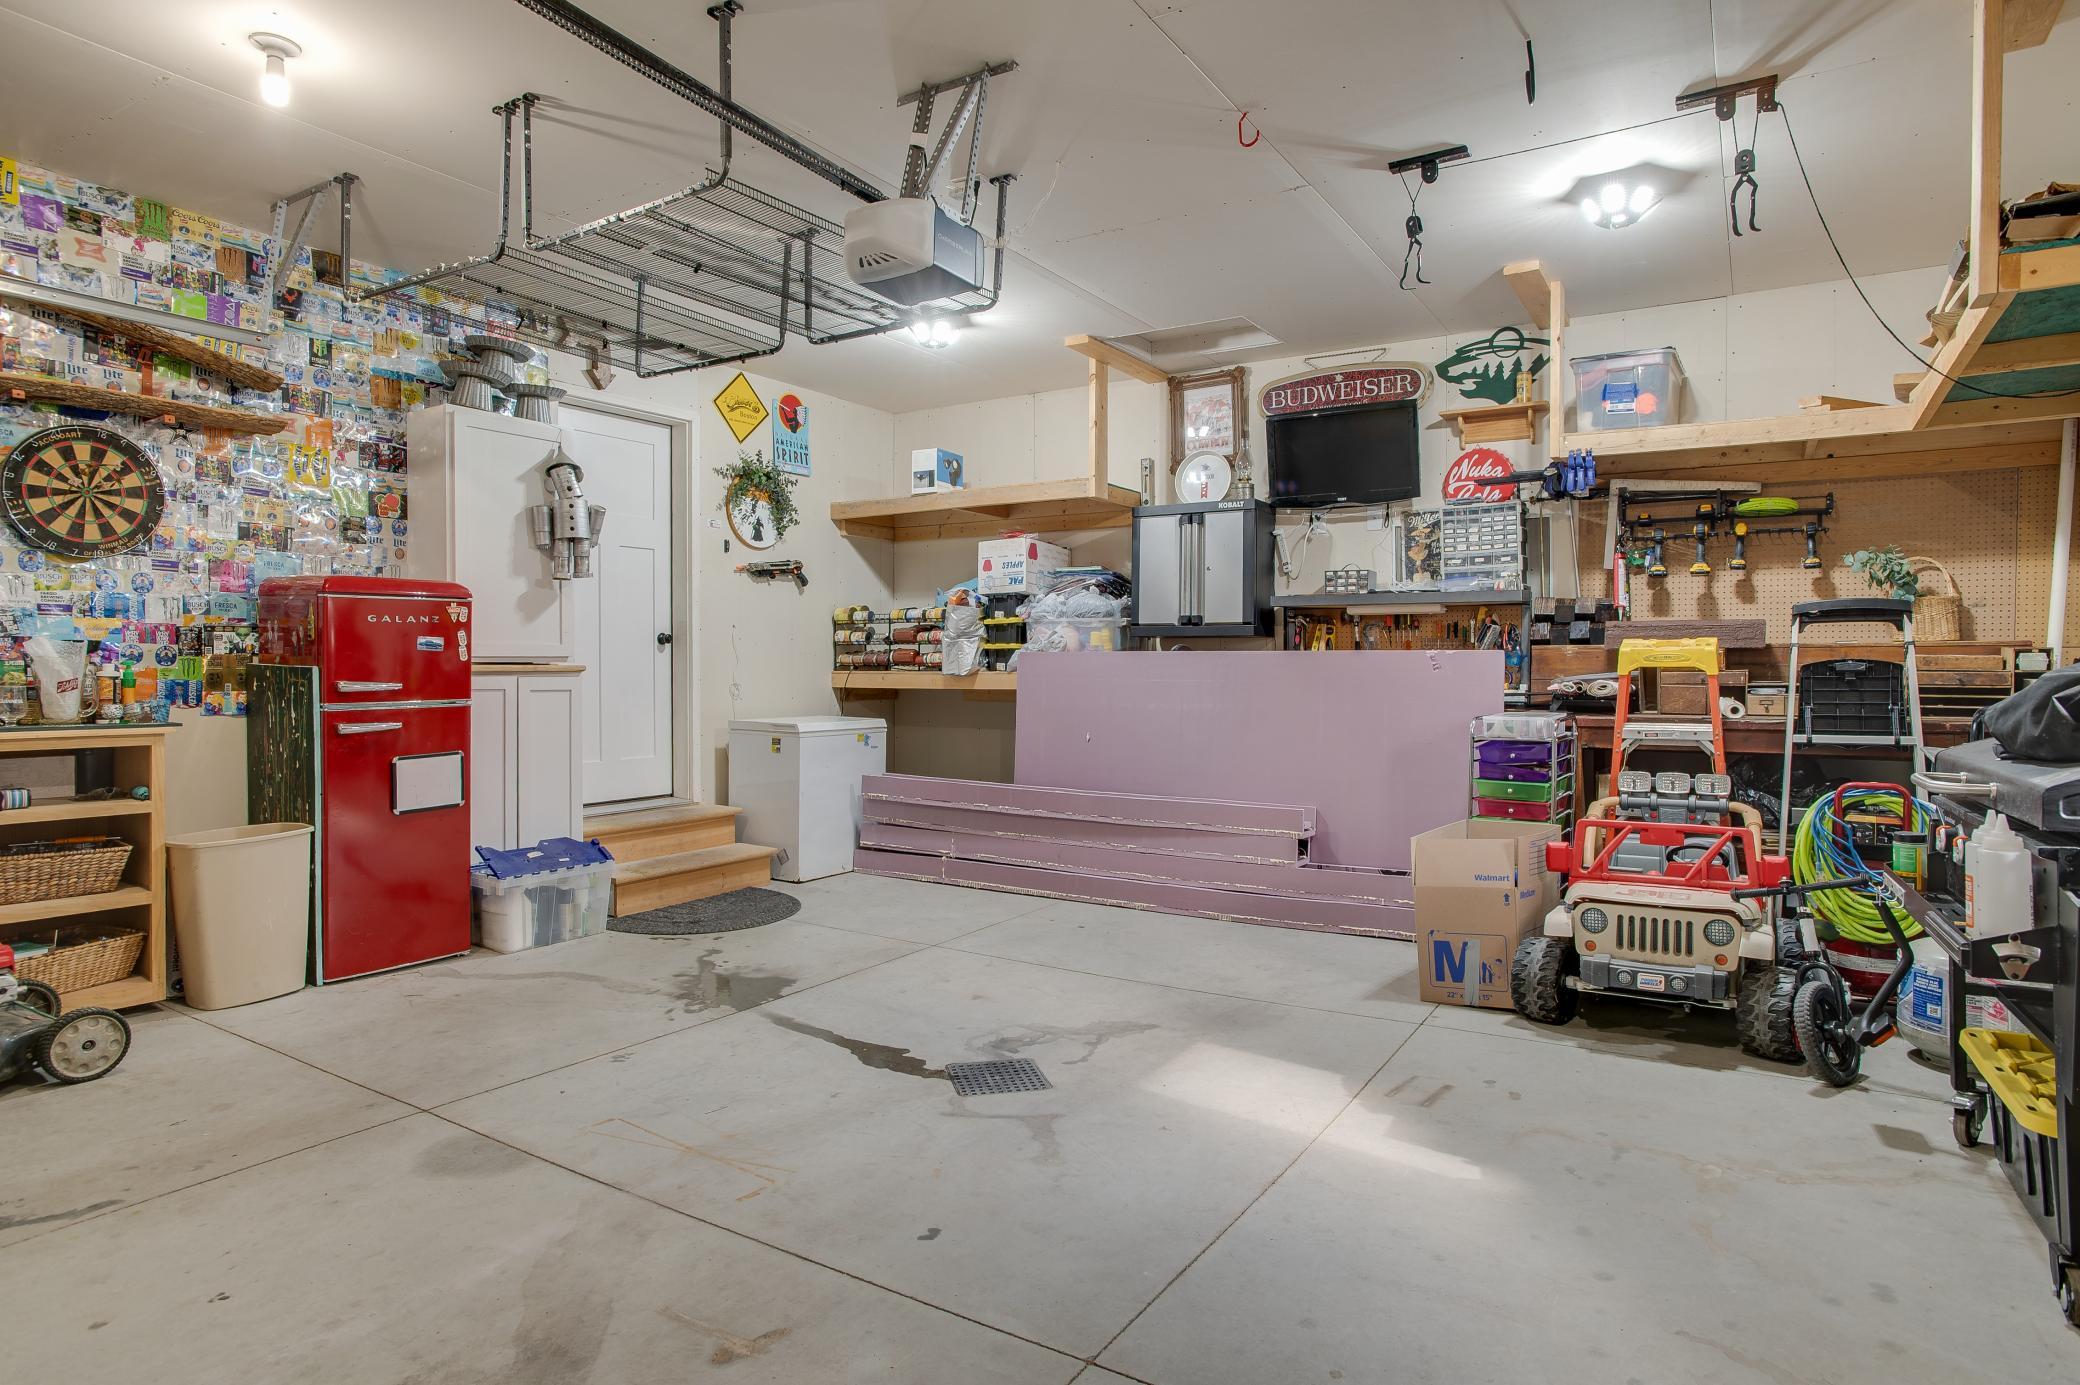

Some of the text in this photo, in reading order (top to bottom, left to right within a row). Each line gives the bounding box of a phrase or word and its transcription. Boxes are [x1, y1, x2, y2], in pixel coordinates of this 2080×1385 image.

[80, 190, 105, 201] BUSCH
[172, 208, 220, 229] Coors Coors
[66, 364, 88, 375] Lite
[103, 368, 123, 379] Lite
[1270, 373, 1414, 409] BUDWEISER
[776, 438, 809, 451] AMERICAN
[176, 447, 194, 458] Lite
[776, 449, 809, 466] SPIRIT
[1451, 459, 1504, 483] Nuka
[1408, 511, 1440, 527] Miller
[393, 539, 407, 547] Lite
[1002, 560, 1024, 570] APPLES
[187, 601, 209, 609] BUSCH
[214, 602, 237, 610] FRESCA
[367, 614, 440, 623] GALANZ
[1474, 874, 1510, 882] Walmart
